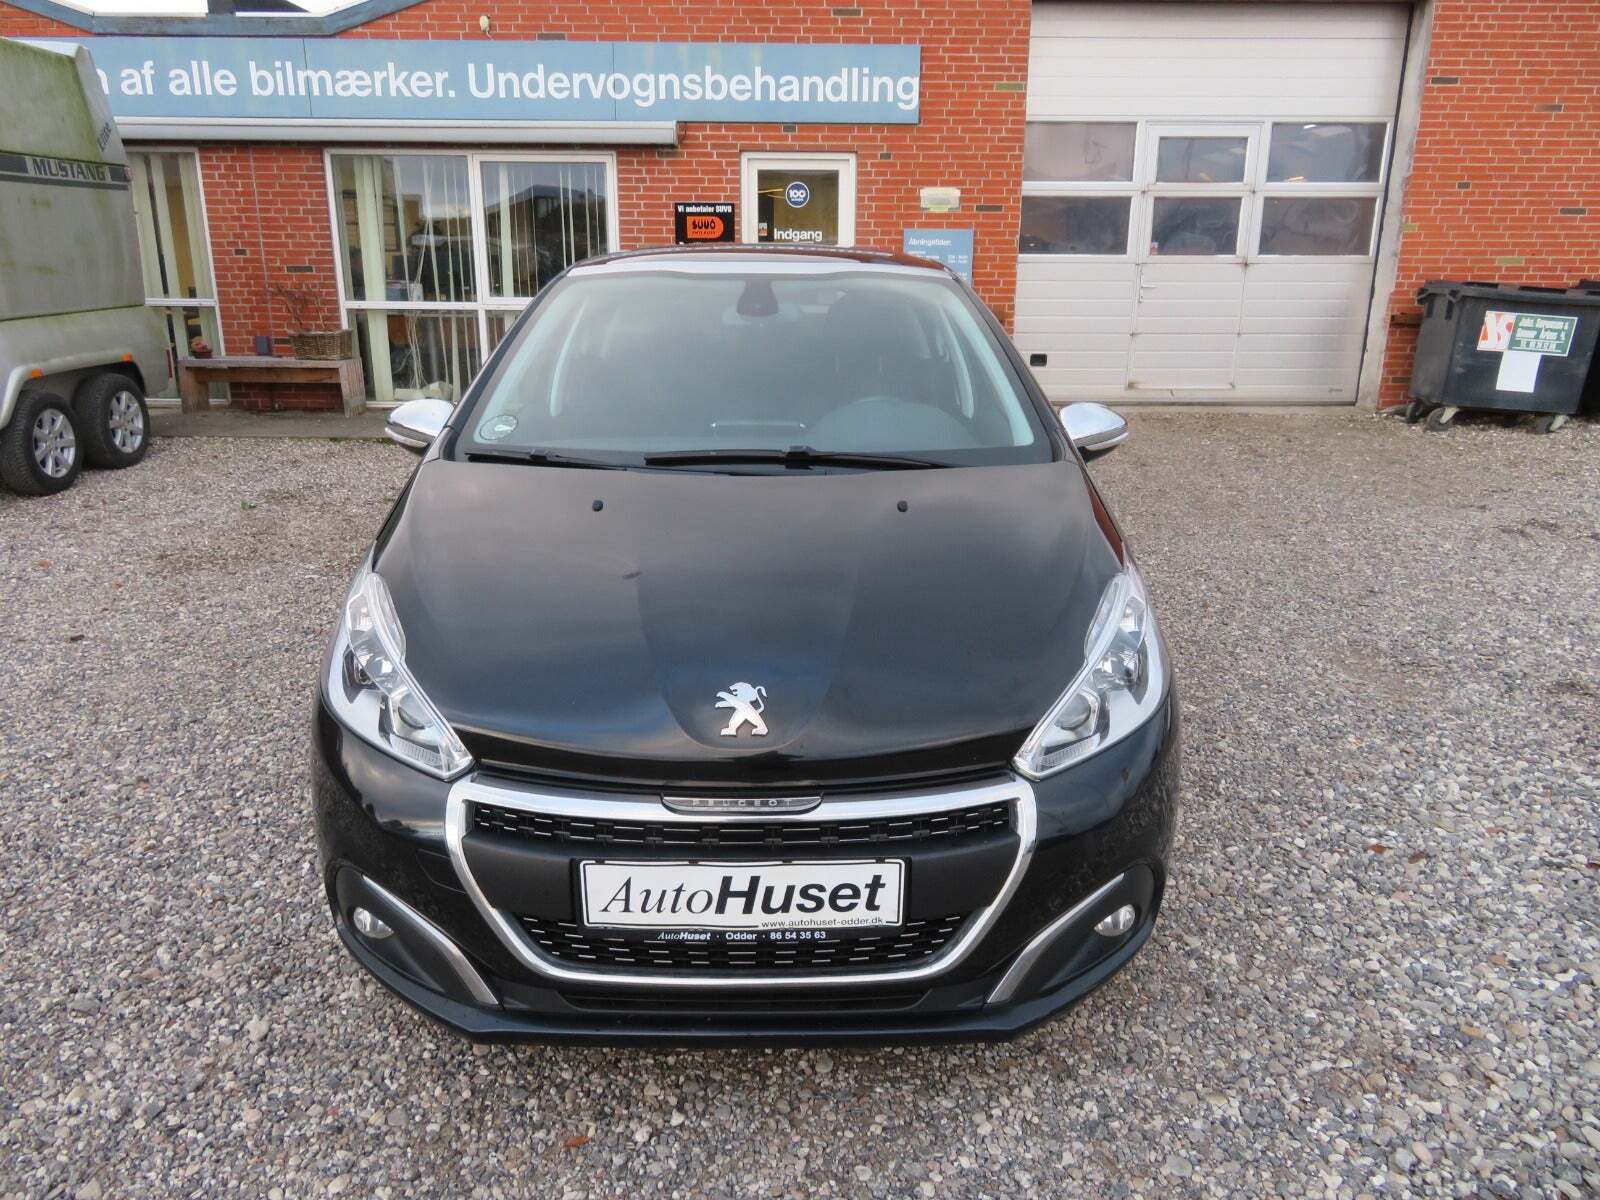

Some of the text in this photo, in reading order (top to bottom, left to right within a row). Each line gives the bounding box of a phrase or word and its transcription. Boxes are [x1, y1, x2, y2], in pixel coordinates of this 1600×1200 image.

[120, 60, 155, 96] af
[168, 60, 238, 96] alle
[248, 60, 456, 99] bilmærker.
[467, 62, 920, 111] Undervognsbehandling
[32, 158, 107, 181] MUSTANG
[773, 227, 823, 242] Indgang
[600, 873, 887, 916] AutoHuset
[761, 917, 884, 928] www.autohuset-odder.dk
[657, 930, 826, 941] AutoHuset Odder 86 54 35 63
